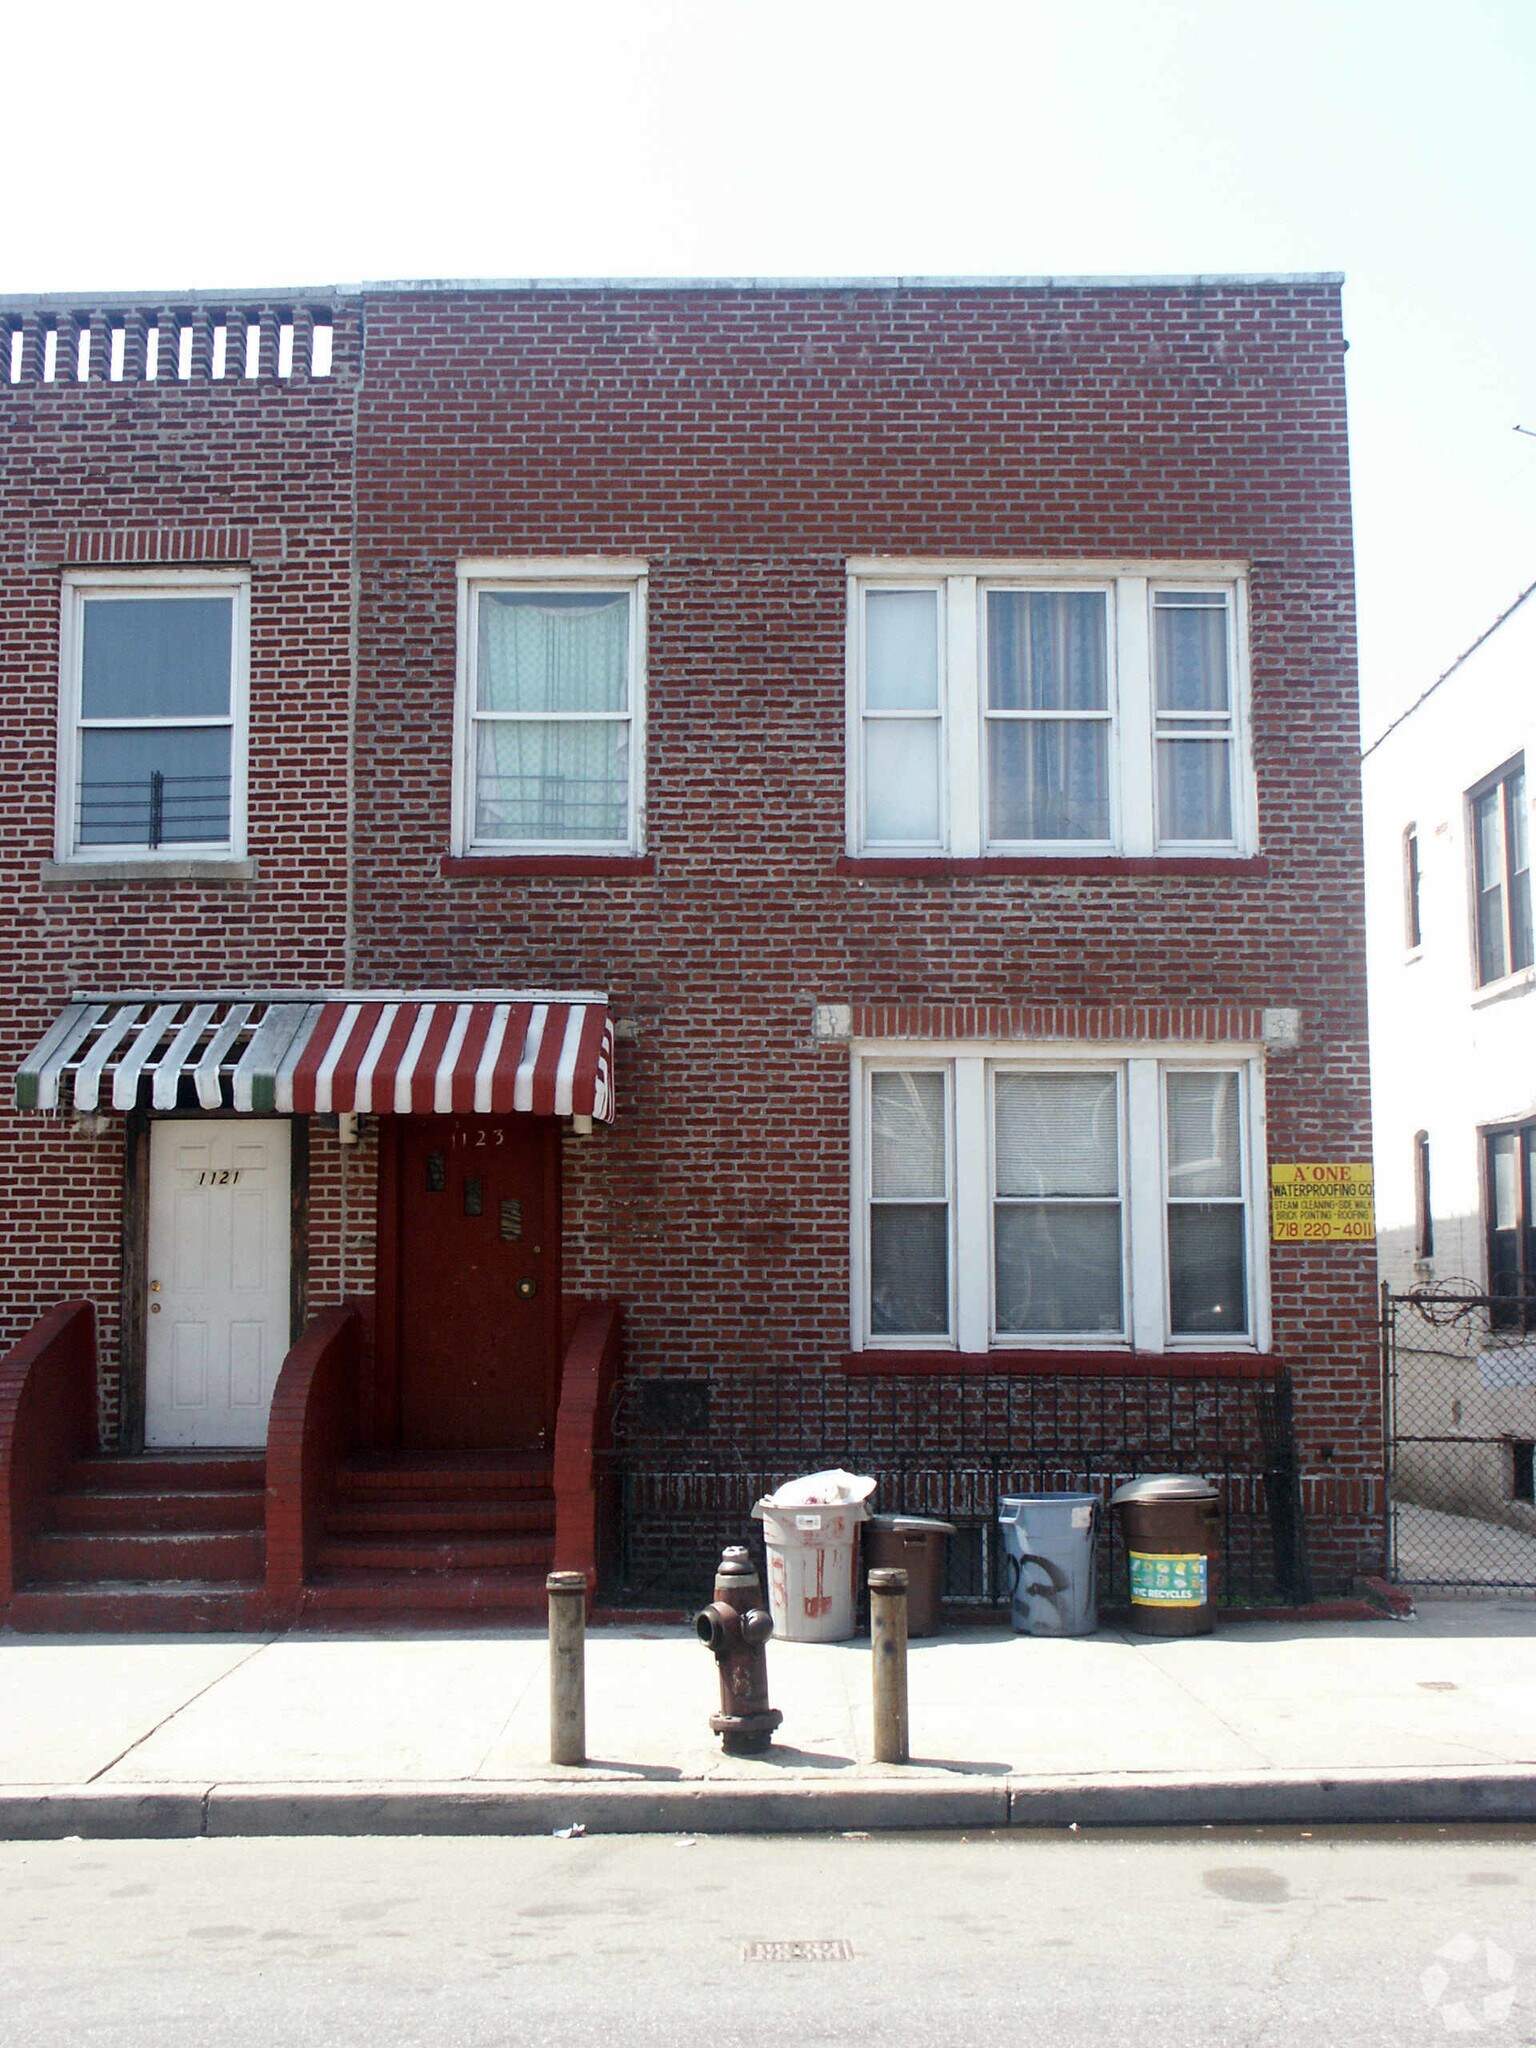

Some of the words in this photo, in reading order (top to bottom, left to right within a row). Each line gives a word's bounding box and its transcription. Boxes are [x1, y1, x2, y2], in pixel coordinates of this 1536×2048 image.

[451, 1129, 504, 1148] 1123
[199, 1171, 239, 1185] 1121
[1273, 1183, 1356, 1197] WATERPROOFING
[1274, 1201, 1298, 1210] STEAM
[1276, 1211, 1297, 1220] BRICK
[1277, 1222, 1299, 1237] 718
[1148, 1589, 1192, 1599] RECYCLES
